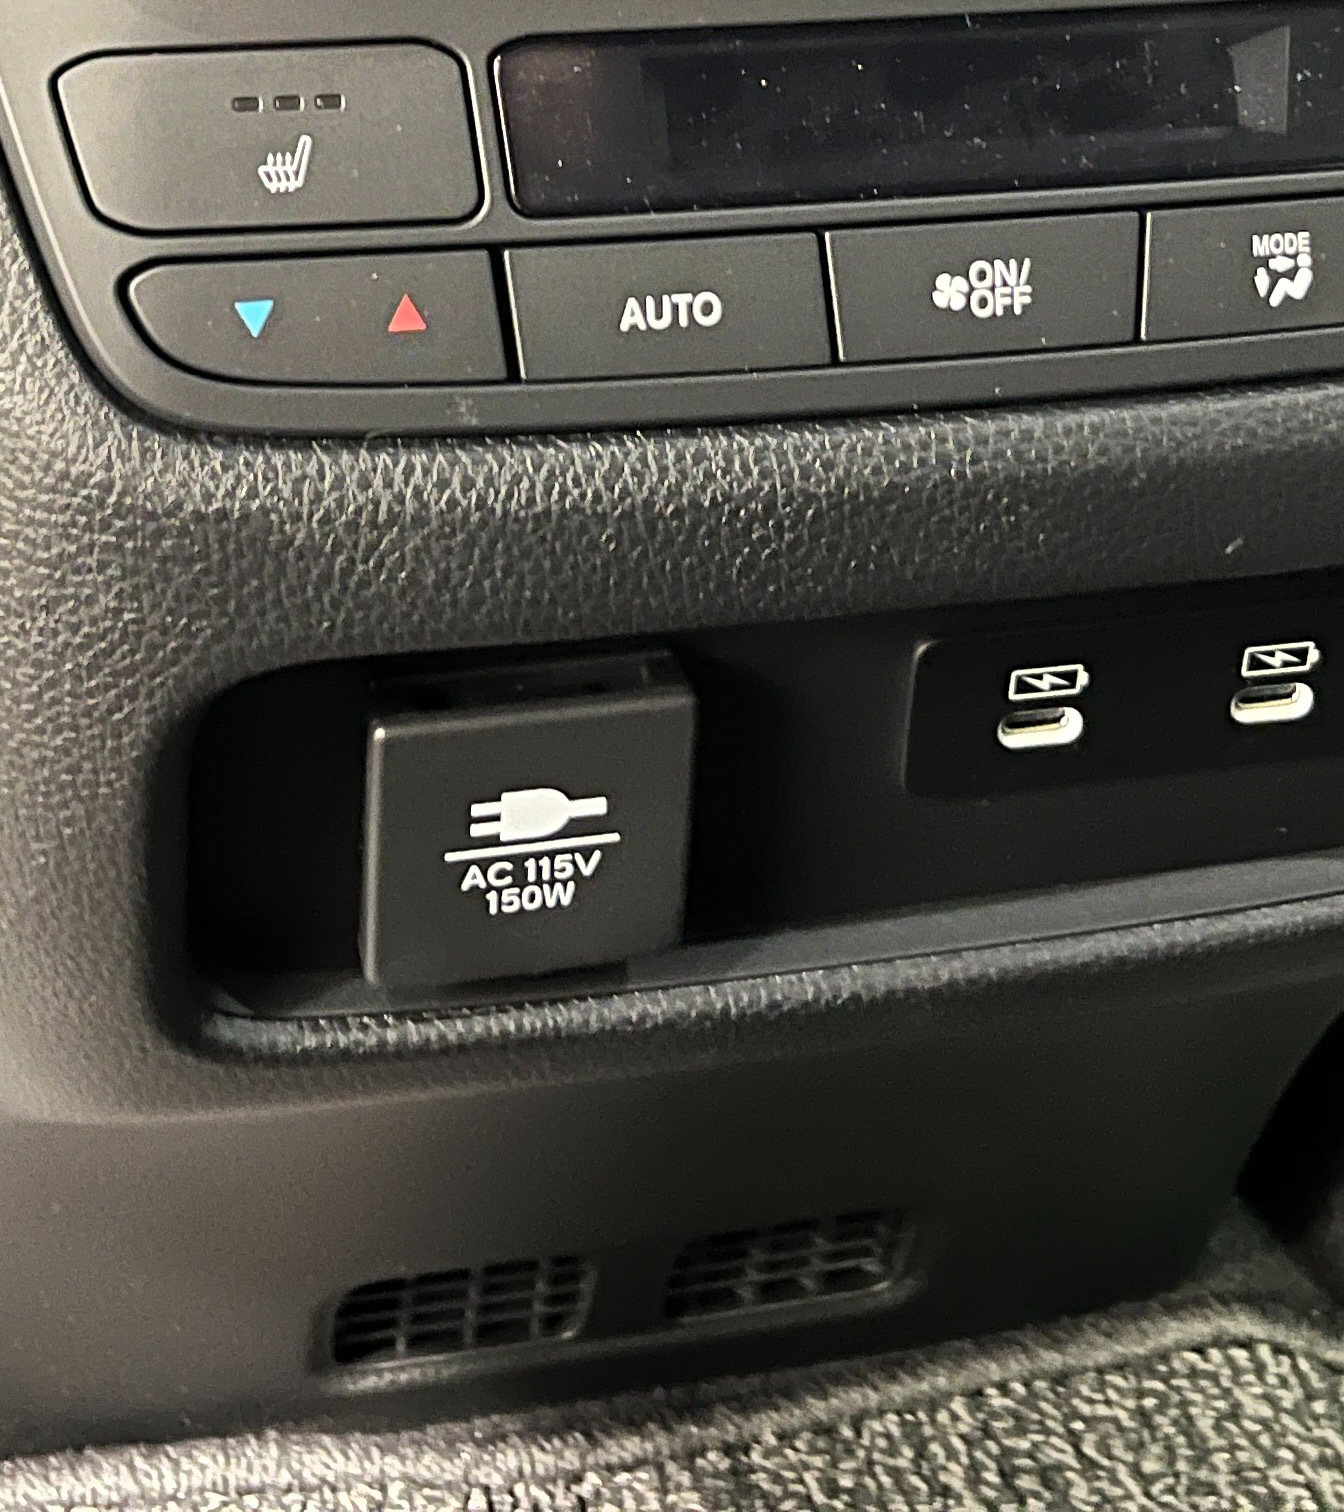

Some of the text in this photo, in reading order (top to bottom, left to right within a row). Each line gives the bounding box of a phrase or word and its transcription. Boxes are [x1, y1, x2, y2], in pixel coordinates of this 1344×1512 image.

[1251, 231, 1311, 257] MODE
[618, 290, 724, 332] AUTO
[969, 284, 1033, 319] OFF
[460, 849, 603, 892] AC 115V
[485, 880, 576, 916] 150W
